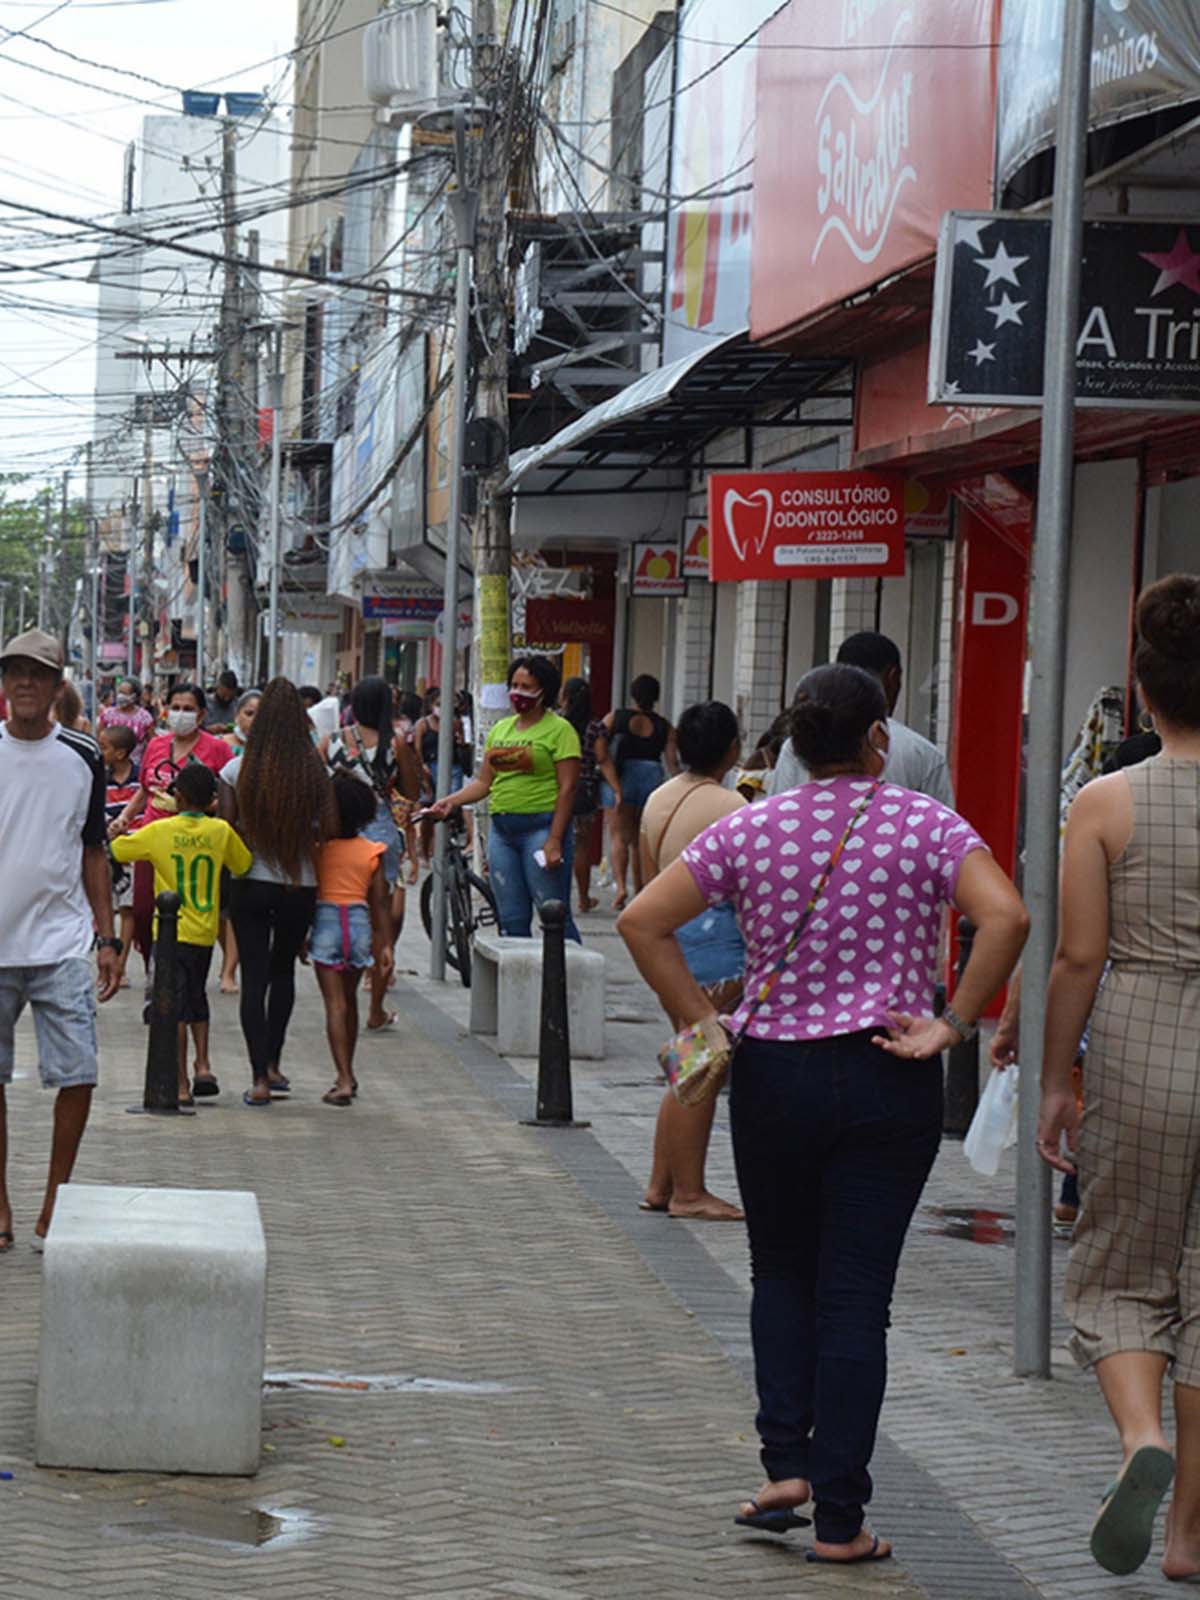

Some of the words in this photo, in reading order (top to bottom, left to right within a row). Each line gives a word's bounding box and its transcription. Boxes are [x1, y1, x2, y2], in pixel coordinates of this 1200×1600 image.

[816, 72, 913, 236] Salvador
[1075, 305, 1118, 358] A
[773, 505, 898, 529] ODONTOLÓGICO
[780, 484, 891, 506] CONSULTÓRIO
[170, 852, 215, 913] 10
